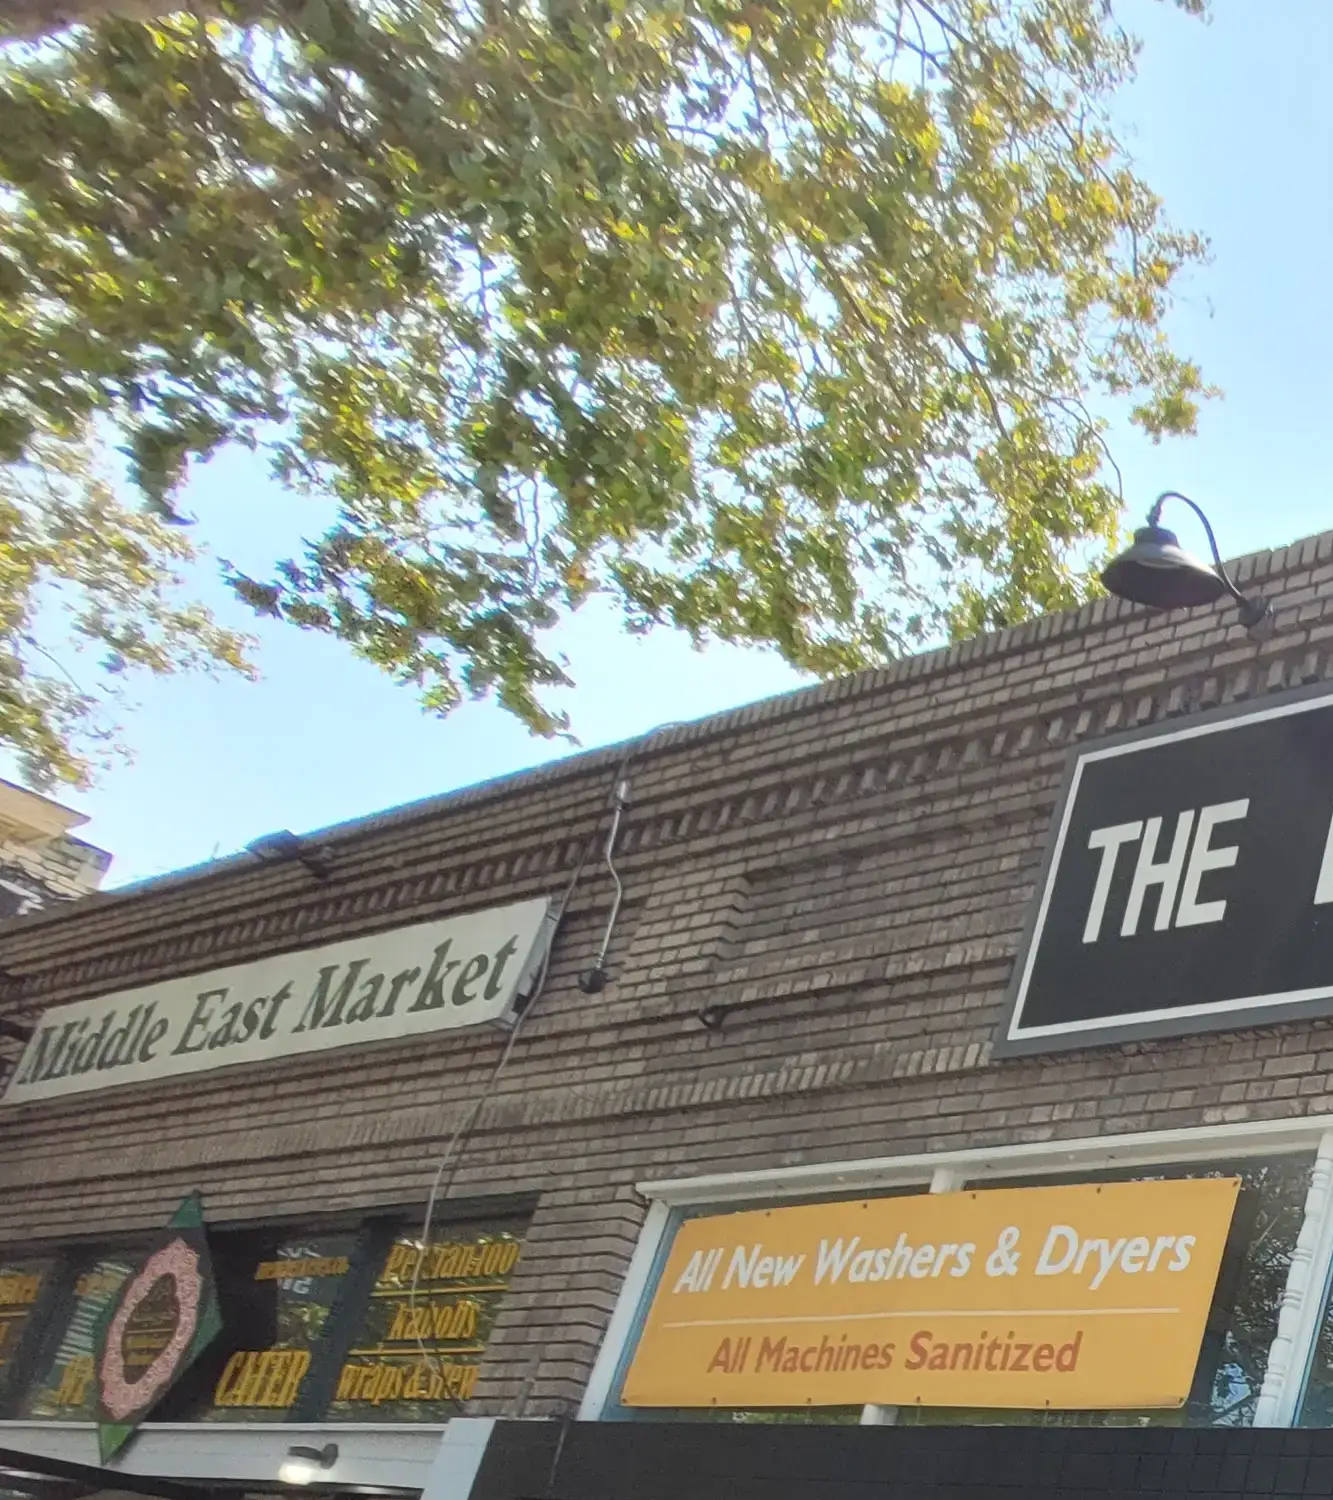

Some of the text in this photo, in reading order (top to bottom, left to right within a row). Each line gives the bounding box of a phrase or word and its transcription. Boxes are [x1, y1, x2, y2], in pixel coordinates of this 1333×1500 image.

[1082, 798, 1250, 943] THE
[17, 933, 520, 1087] Middle East Market
[672, 1224, 1197, 1294] All New Washers & Dryers
[707, 1330, 1085, 1374] All Machines Sanitized
